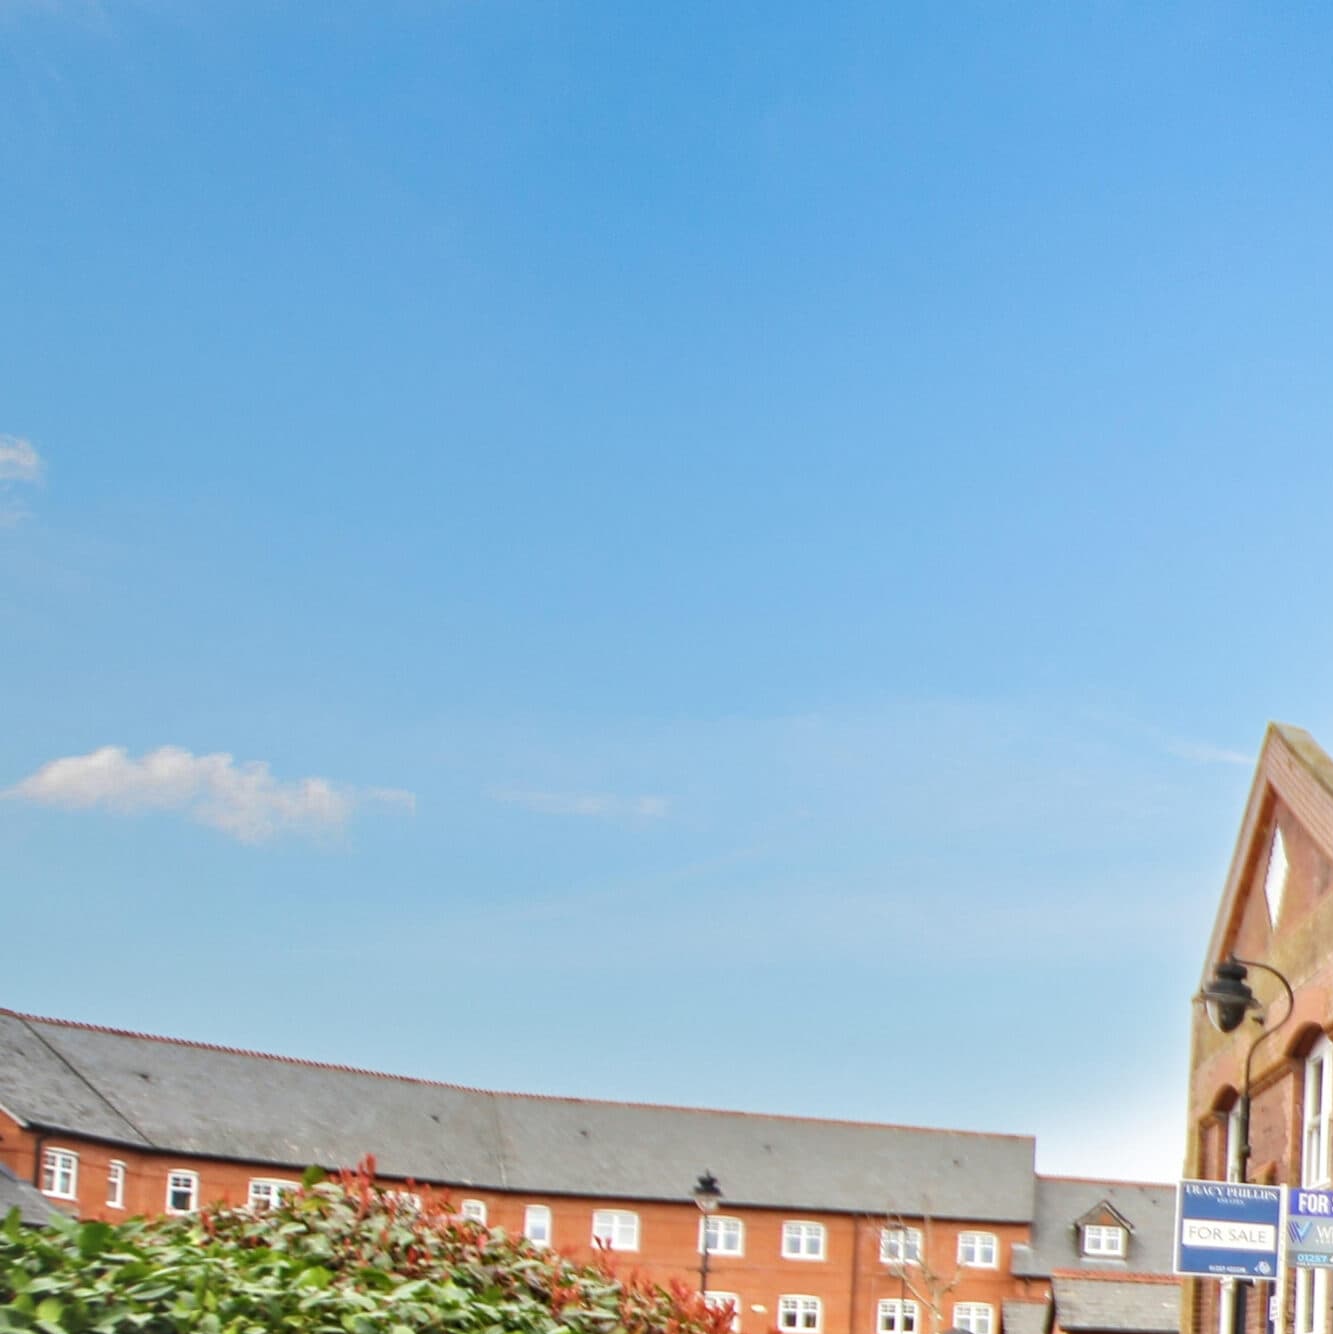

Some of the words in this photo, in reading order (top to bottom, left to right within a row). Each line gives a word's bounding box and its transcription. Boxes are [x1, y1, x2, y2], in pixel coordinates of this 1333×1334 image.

[1185, 1184, 1225, 1197] TRACY
[1226, 1187, 1278, 1200] PHILLIPS
[1299, 1192, 1328, 1214] FOR
[1189, 1225, 1223, 1240] FOR
[1228, 1228, 1266, 1244] SALE
